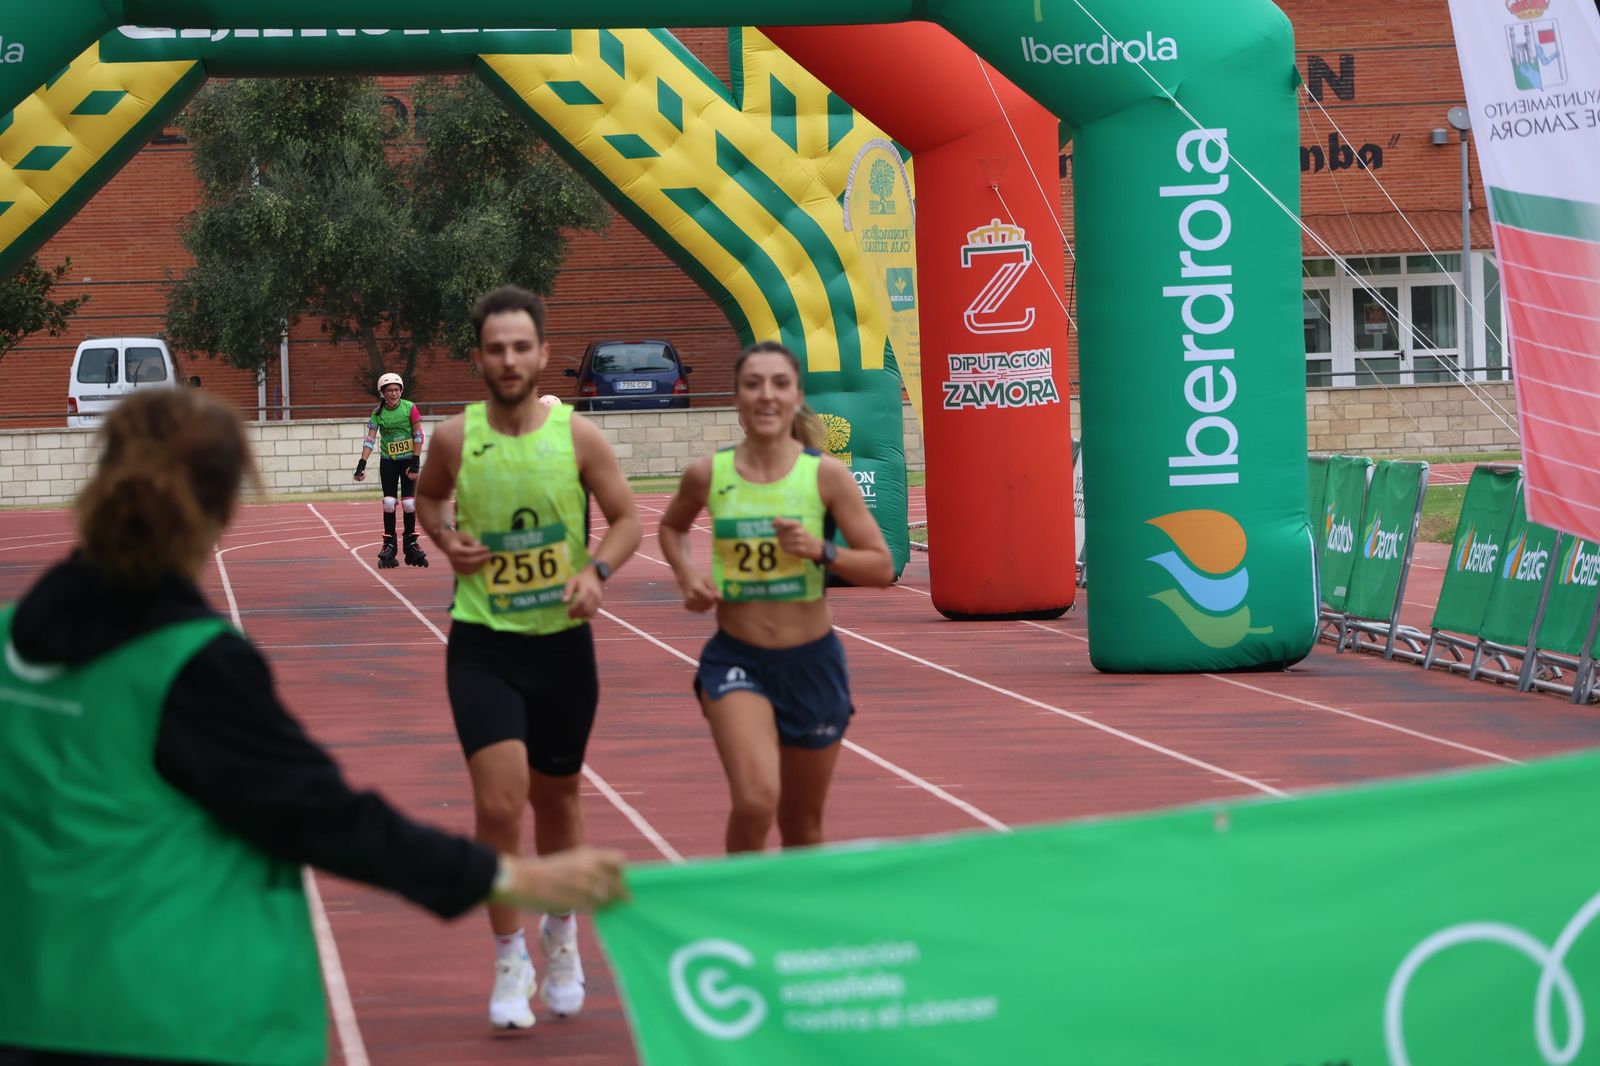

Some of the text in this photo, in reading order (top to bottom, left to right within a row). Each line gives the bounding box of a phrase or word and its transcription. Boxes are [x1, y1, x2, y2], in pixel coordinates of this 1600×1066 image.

[1021, 31, 1177, 65] Iberdrola
[1159, 128, 1239, 487] Iberdrola
[943, 378, 1058, 408] ZAMORA
[390, 440, 410, 453] 6193
[850, 471, 876, 485] ON
[490, 548, 557, 585] 256
[735, 541, 777, 572] 28
